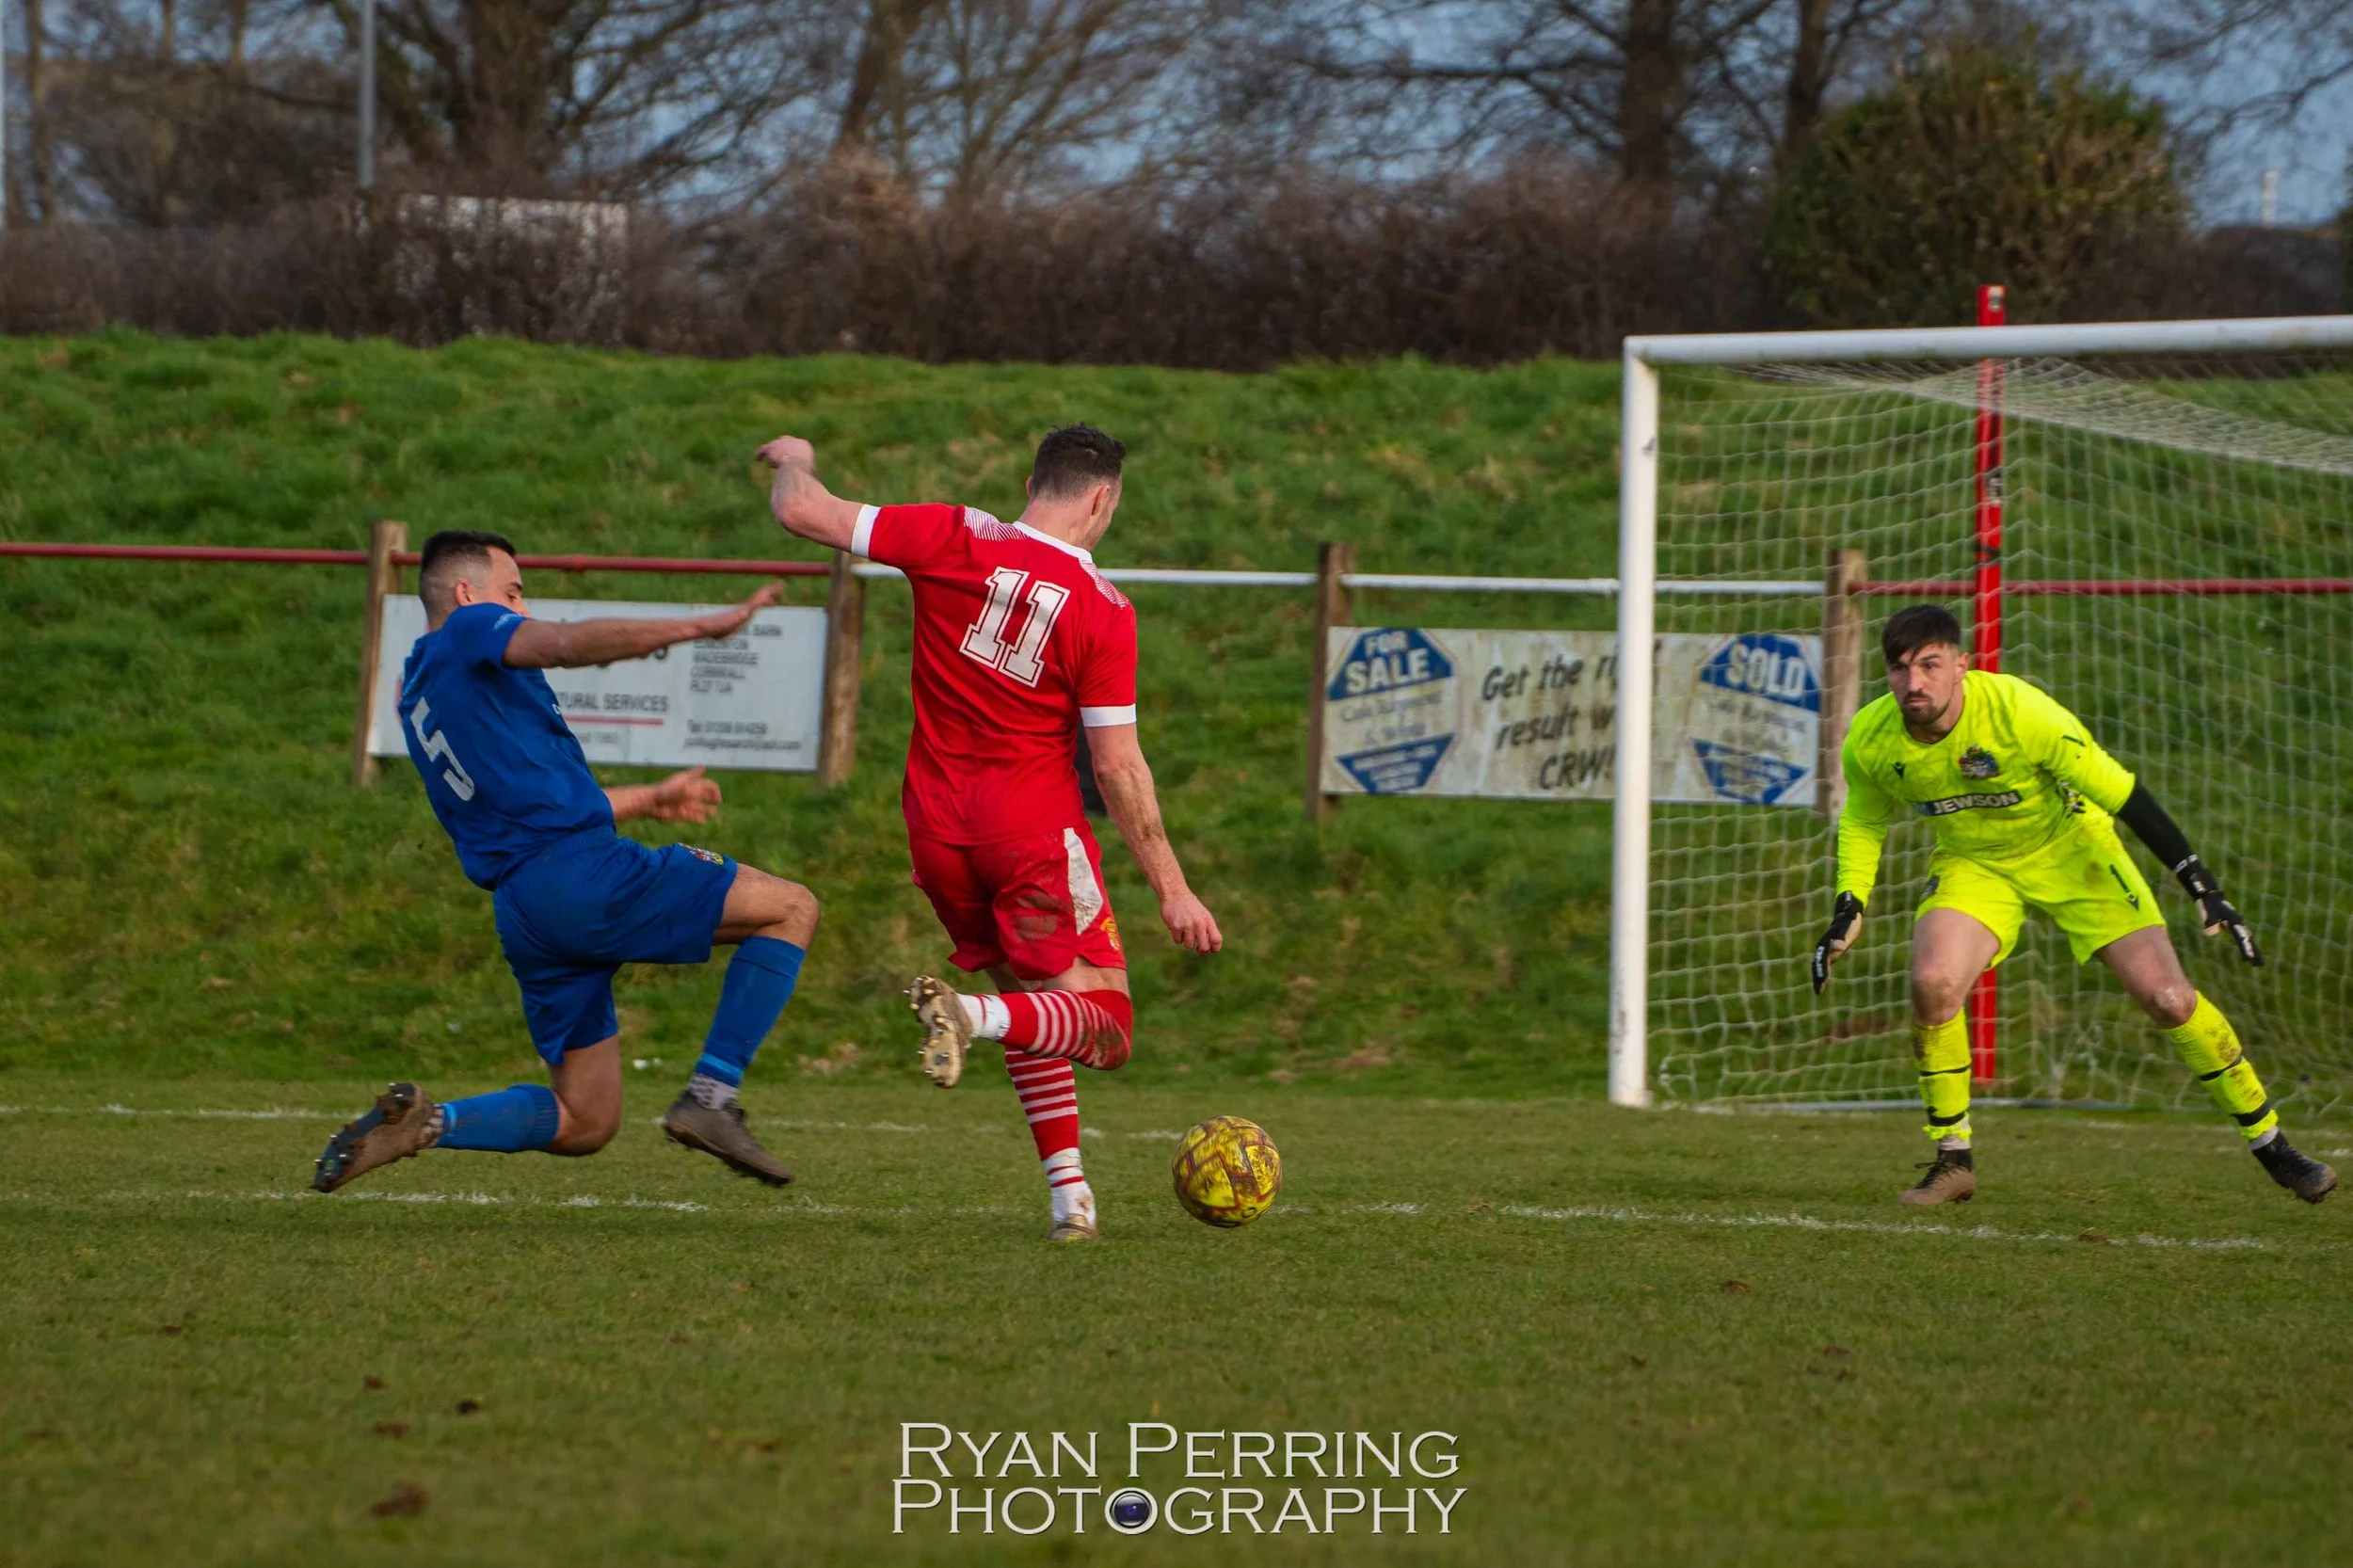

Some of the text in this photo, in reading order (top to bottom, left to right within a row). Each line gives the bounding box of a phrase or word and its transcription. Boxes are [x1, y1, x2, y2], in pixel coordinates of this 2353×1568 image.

[959, 567, 1070, 688] 11
[1365, 631, 1409, 657] FOR
[1346, 648, 1431, 693] SALE
[1481, 664, 1530, 701] Get
[1539, 652, 1584, 690] the
[1725, 642, 1806, 698] SOLD
[603, 693, 670, 712] SERVICES
[1494, 702, 1581, 750] result
[410, 696, 475, 802] 5
[1933, 792, 2021, 815] JEWSON
